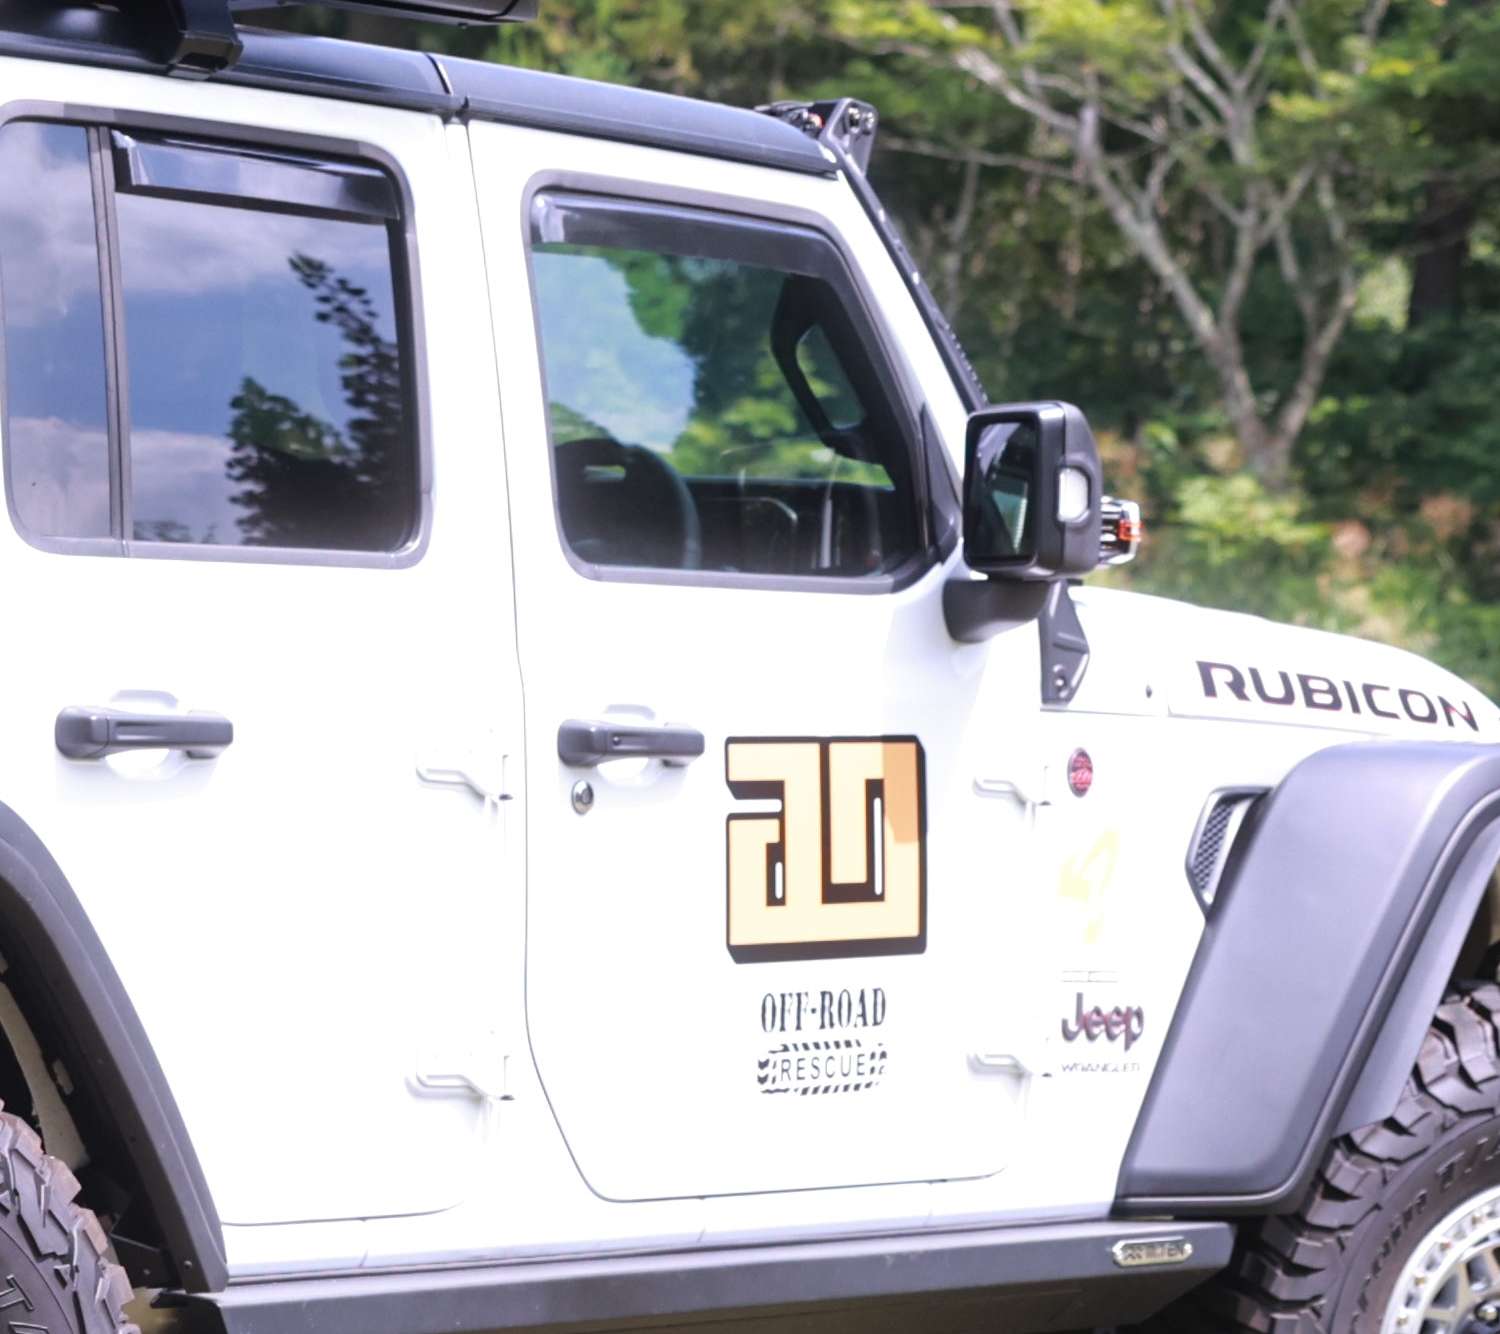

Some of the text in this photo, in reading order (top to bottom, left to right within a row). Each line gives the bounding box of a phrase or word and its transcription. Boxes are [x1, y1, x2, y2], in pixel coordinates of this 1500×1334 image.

[1195, 660, 1480, 733] RUBICON
[1060, 991, 1145, 1054] Jeep
[779, 1053, 867, 1083] RESCUE
